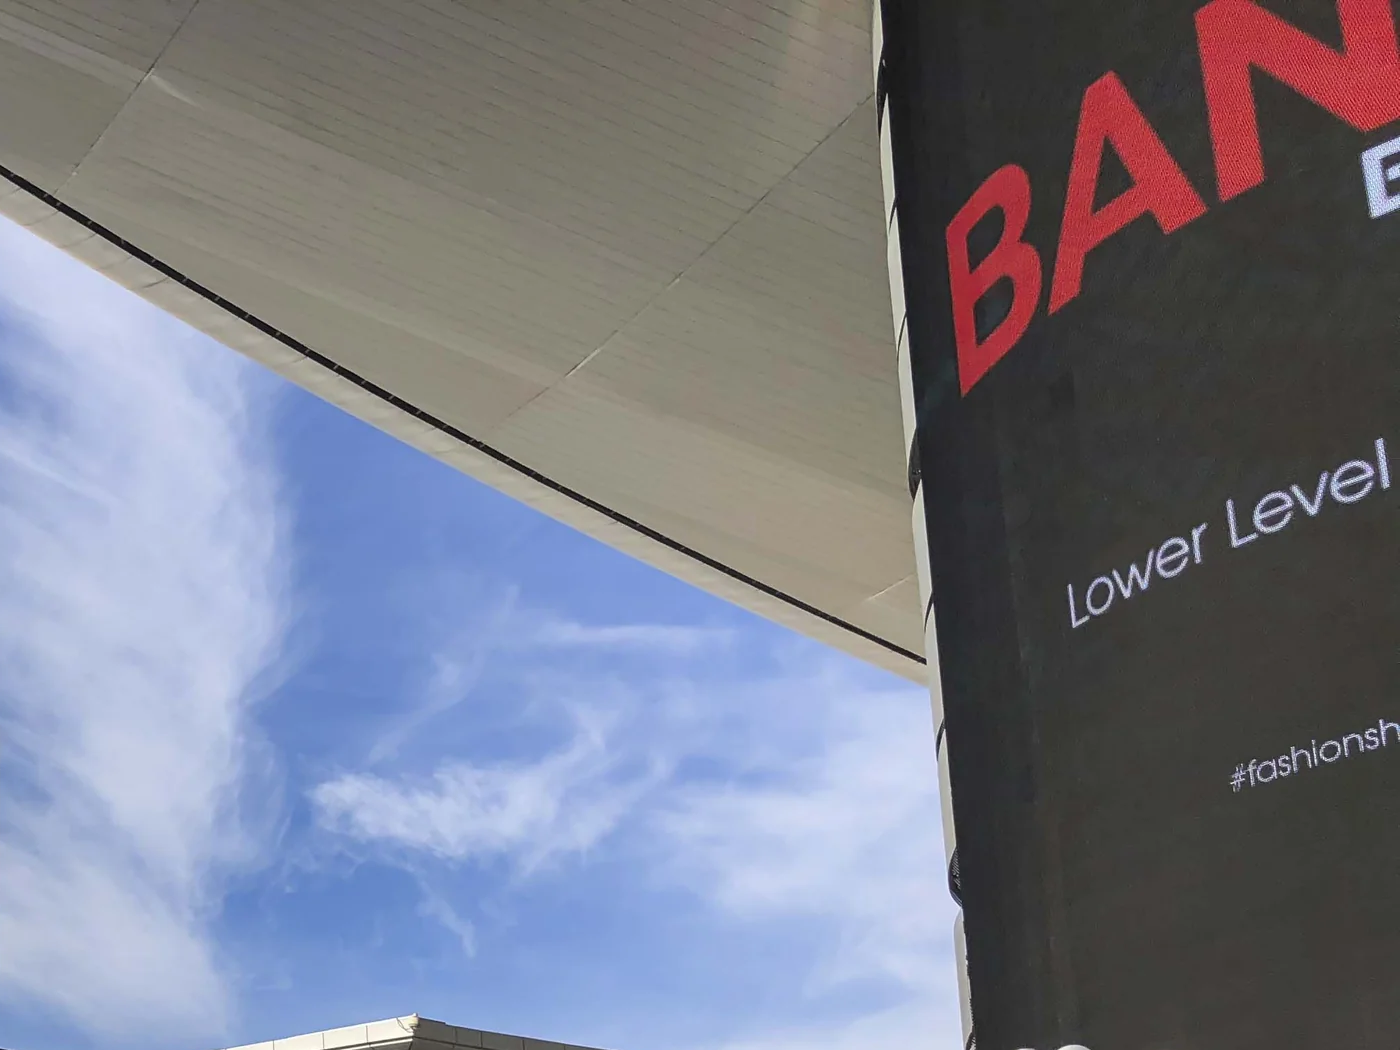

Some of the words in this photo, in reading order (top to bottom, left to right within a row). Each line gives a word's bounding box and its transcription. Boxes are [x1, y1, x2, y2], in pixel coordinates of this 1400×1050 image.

[946, 0, 1400, 398] BAN
[1067, 522, 1208, 628] Lower
[1225, 437, 1391, 549] Level
